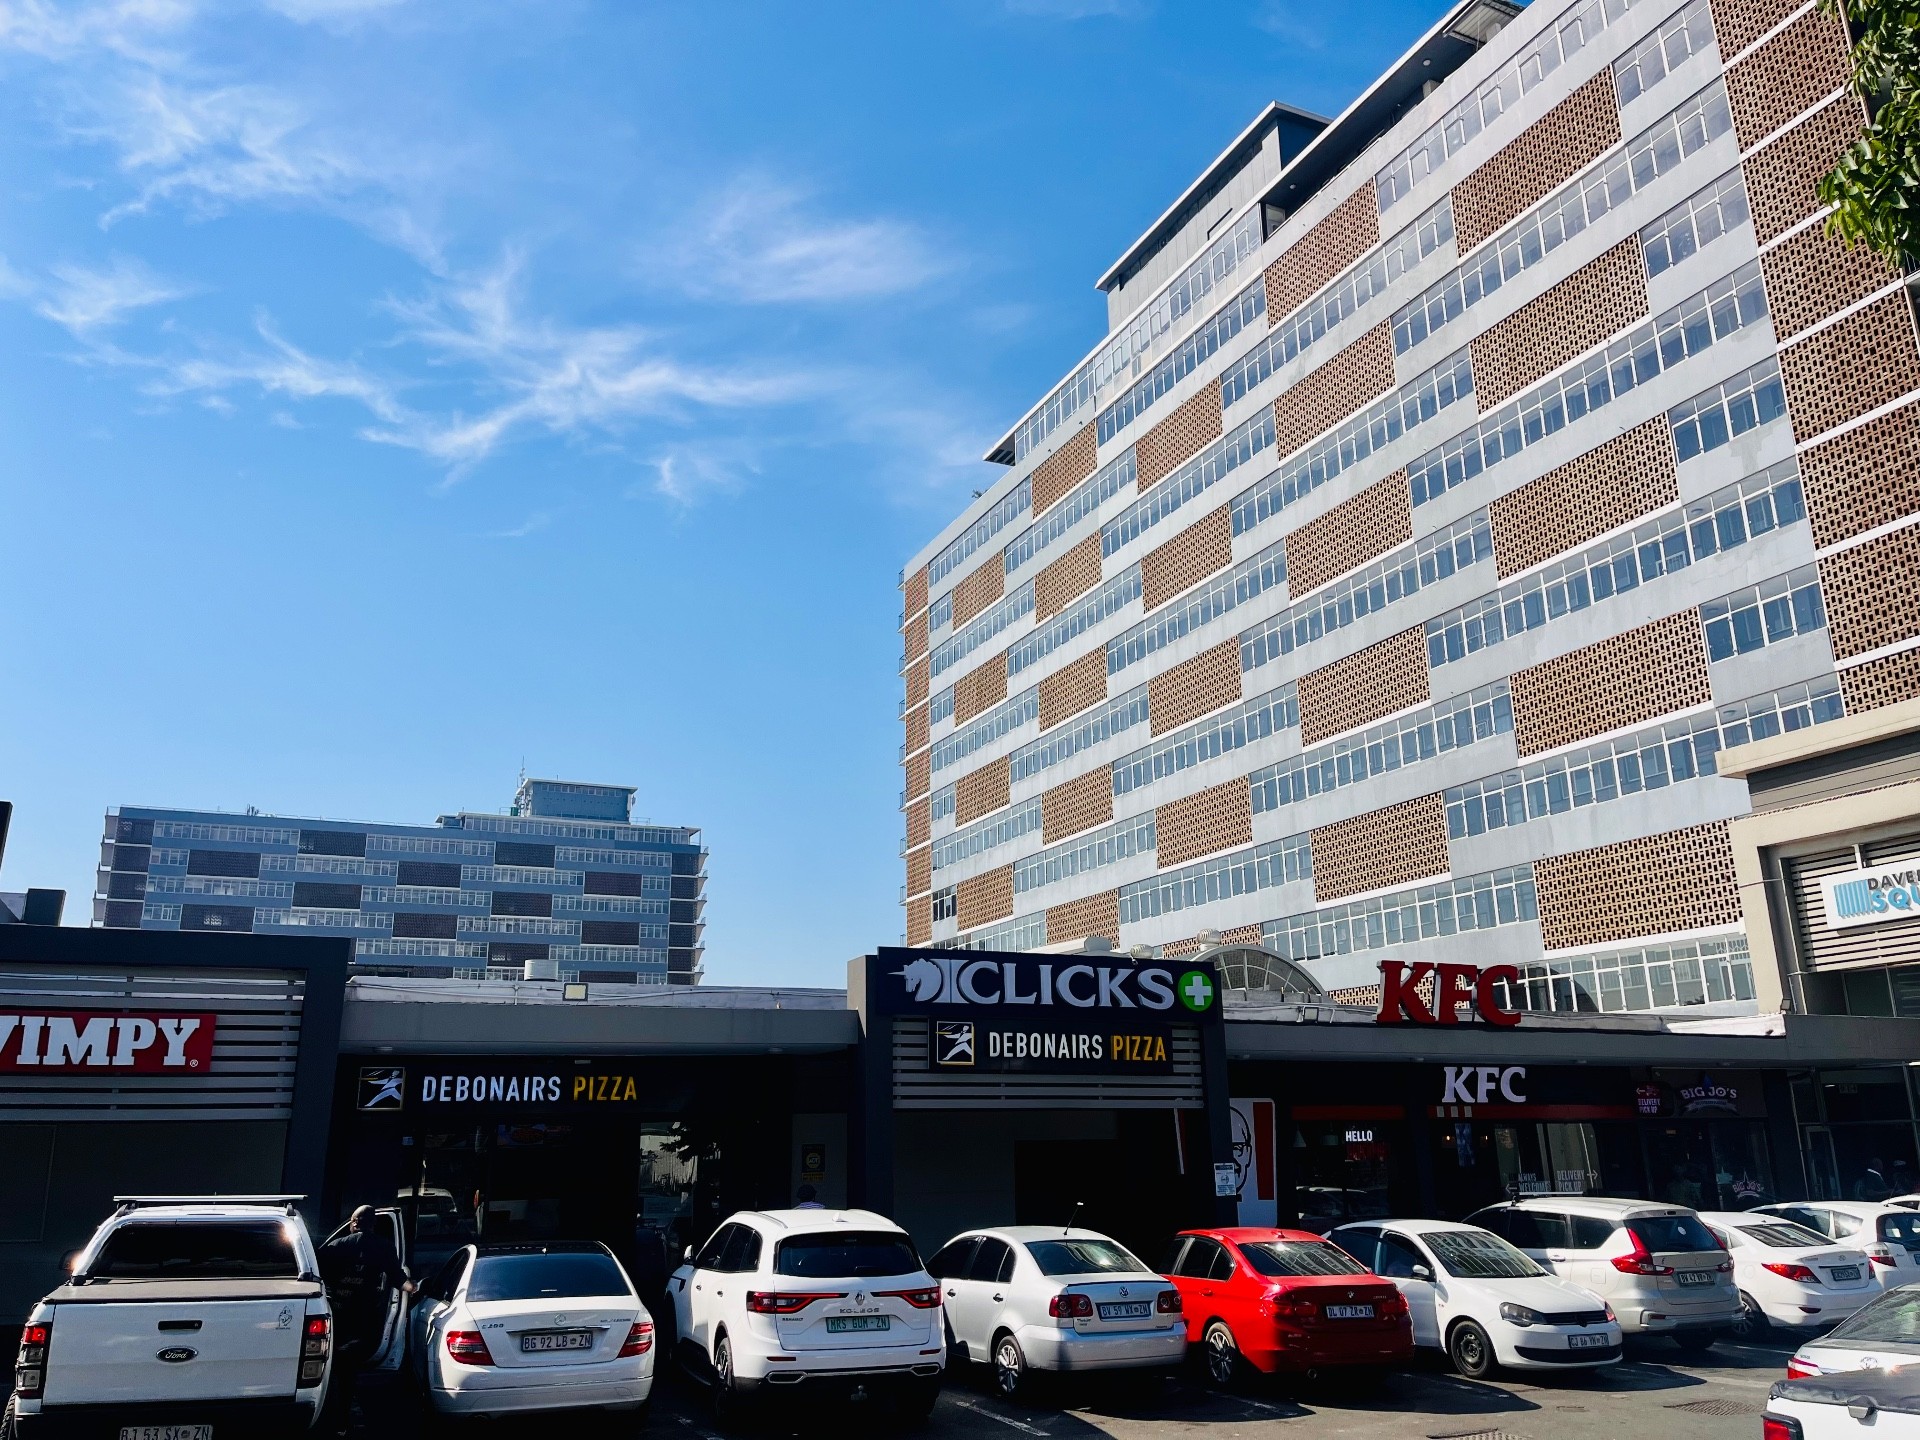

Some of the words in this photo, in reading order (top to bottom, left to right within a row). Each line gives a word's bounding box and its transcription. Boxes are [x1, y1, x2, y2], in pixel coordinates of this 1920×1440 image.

[1868, 869, 1920, 890] DAVE
[958, 960, 1176, 1011] CLICKS
[1375, 960, 1522, 1026] KFC
[989, 1031, 1103, 1060] DEBONAIRS
[1111, 1034, 1167, 1062] PIZZA
[422, 1076, 562, 1101] DEBONAIRS
[573, 1076, 638, 1101] PIZZA
[1442, 1066, 1527, 1104] KFC
[1680, 1087, 1705, 1099] BIG
[1708, 1086, 1737, 1099] JO'S
[1345, 1130, 1373, 1142] HELLO
[1557, 1170, 1584, 1181] DELIVERY
[1559, 1181, 1573, 1192] PICK
[831, 1318, 847, 1330] MRS
[876, 1316, 887, 1328] ZN
[524, 1337, 536, 1349] BG
[540, 1336, 552, 1348] 92
[556, 1335, 568, 1348] LB
[578, 1334, 591, 1347] ZN
[165, 1350, 189, 1359] Ford
